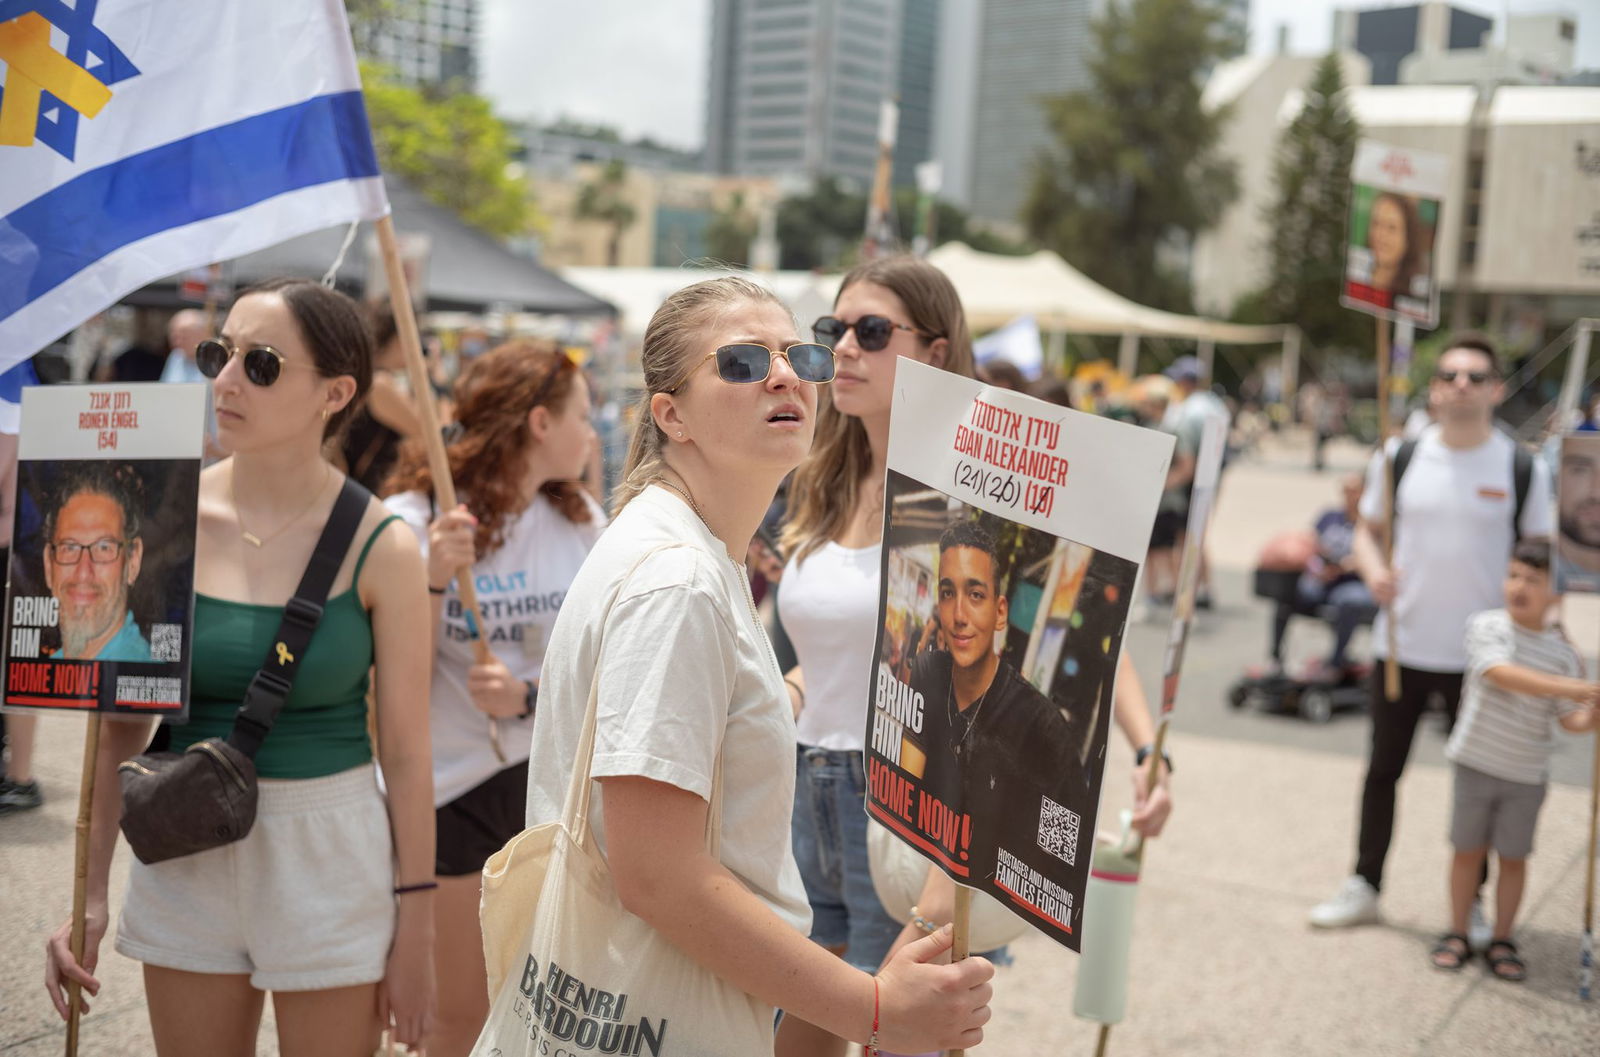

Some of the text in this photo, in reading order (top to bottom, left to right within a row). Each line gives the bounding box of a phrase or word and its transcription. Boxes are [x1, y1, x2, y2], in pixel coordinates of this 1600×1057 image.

[79, 411, 138, 429] RONEN ENGEL
[97, 430, 118, 451] (54)
[971, 399, 1061, 451] עידן אלכסנדר
[954, 424, 1069, 487] EDAN ALEXANDER
[12, 596, 60, 628] BRING
[10, 628, 41, 658] HIM
[8, 662, 99, 697] HOME NOW!
[875, 667, 924, 734] BRING
[871, 710, 904, 768] HIM
[869, 756, 974, 861] HOME NOW!
[995, 861, 1072, 929] FAMILIES FORUM
[997, 847, 1074, 908] HOSTAGES AND MISSING
[512, 996, 525, 1018] LE
[519, 953, 667, 1057] BARDOUIN
[547, 961, 628, 1023] HENRI
